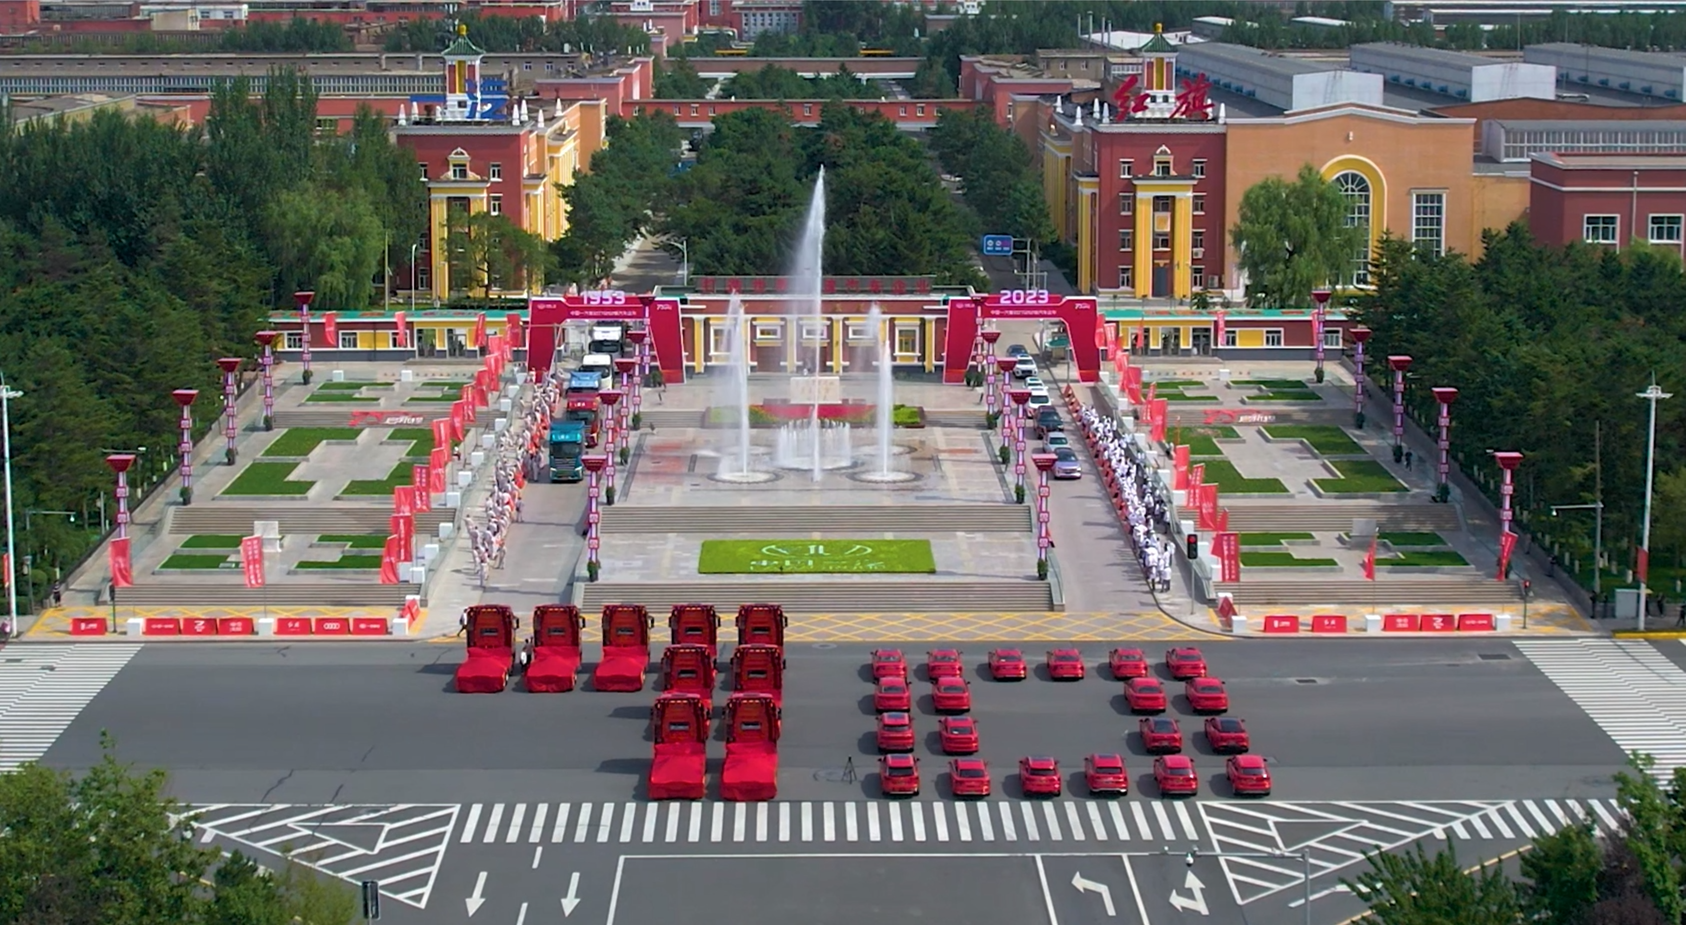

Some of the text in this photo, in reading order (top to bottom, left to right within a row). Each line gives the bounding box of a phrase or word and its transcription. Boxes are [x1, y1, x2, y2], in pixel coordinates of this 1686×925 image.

[1114, 73, 1215, 121] 红旗
[580, 290, 626, 305] 1953
[1000, 289, 1049, 304] 2023
